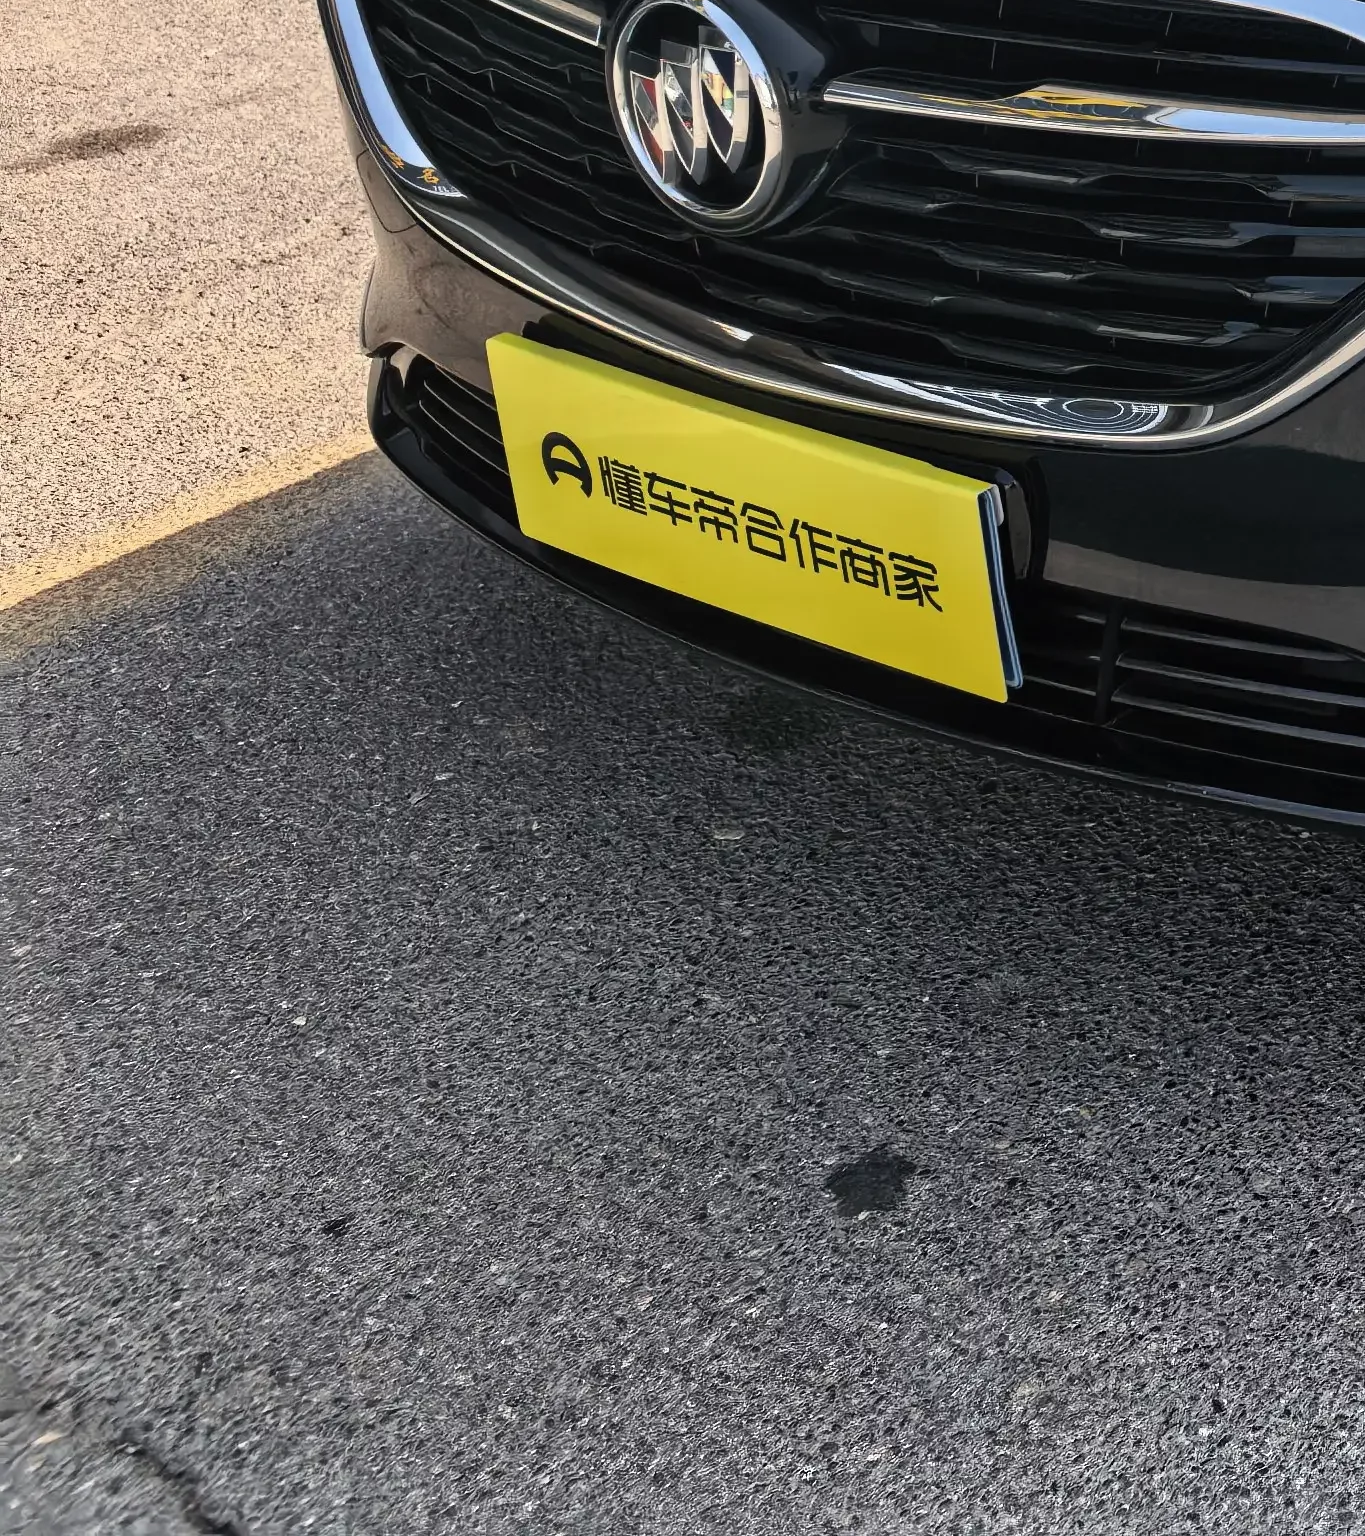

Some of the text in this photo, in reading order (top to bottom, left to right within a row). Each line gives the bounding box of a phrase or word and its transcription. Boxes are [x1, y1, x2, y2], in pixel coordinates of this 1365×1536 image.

[597, 455, 944, 613] 懂车帝合作商家
